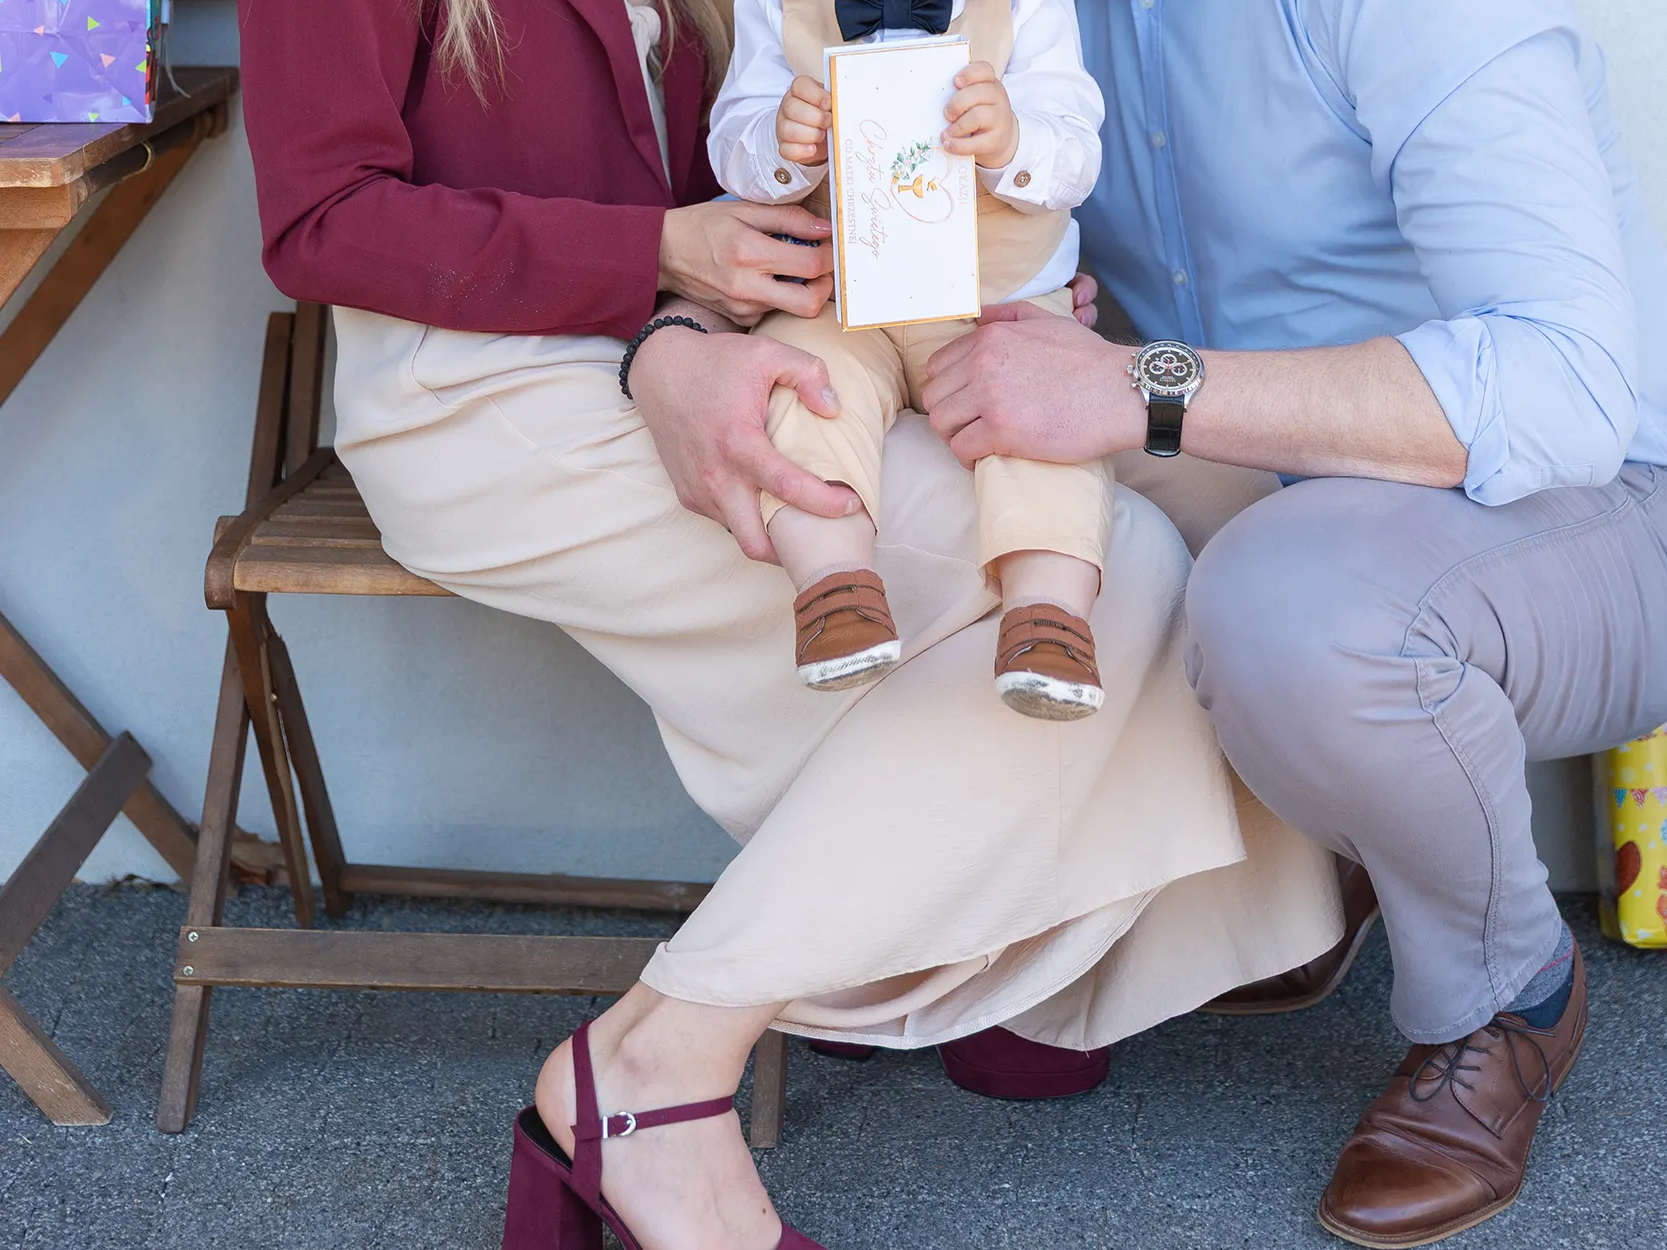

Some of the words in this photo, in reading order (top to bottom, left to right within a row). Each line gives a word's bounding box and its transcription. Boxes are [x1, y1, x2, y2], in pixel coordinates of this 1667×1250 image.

[844, 138, 853, 153] OD
[855, 119, 887, 184] Chrztu
[845, 156, 854, 186] MATKI
[846, 188, 857, 245] CHRZESTNEJ
